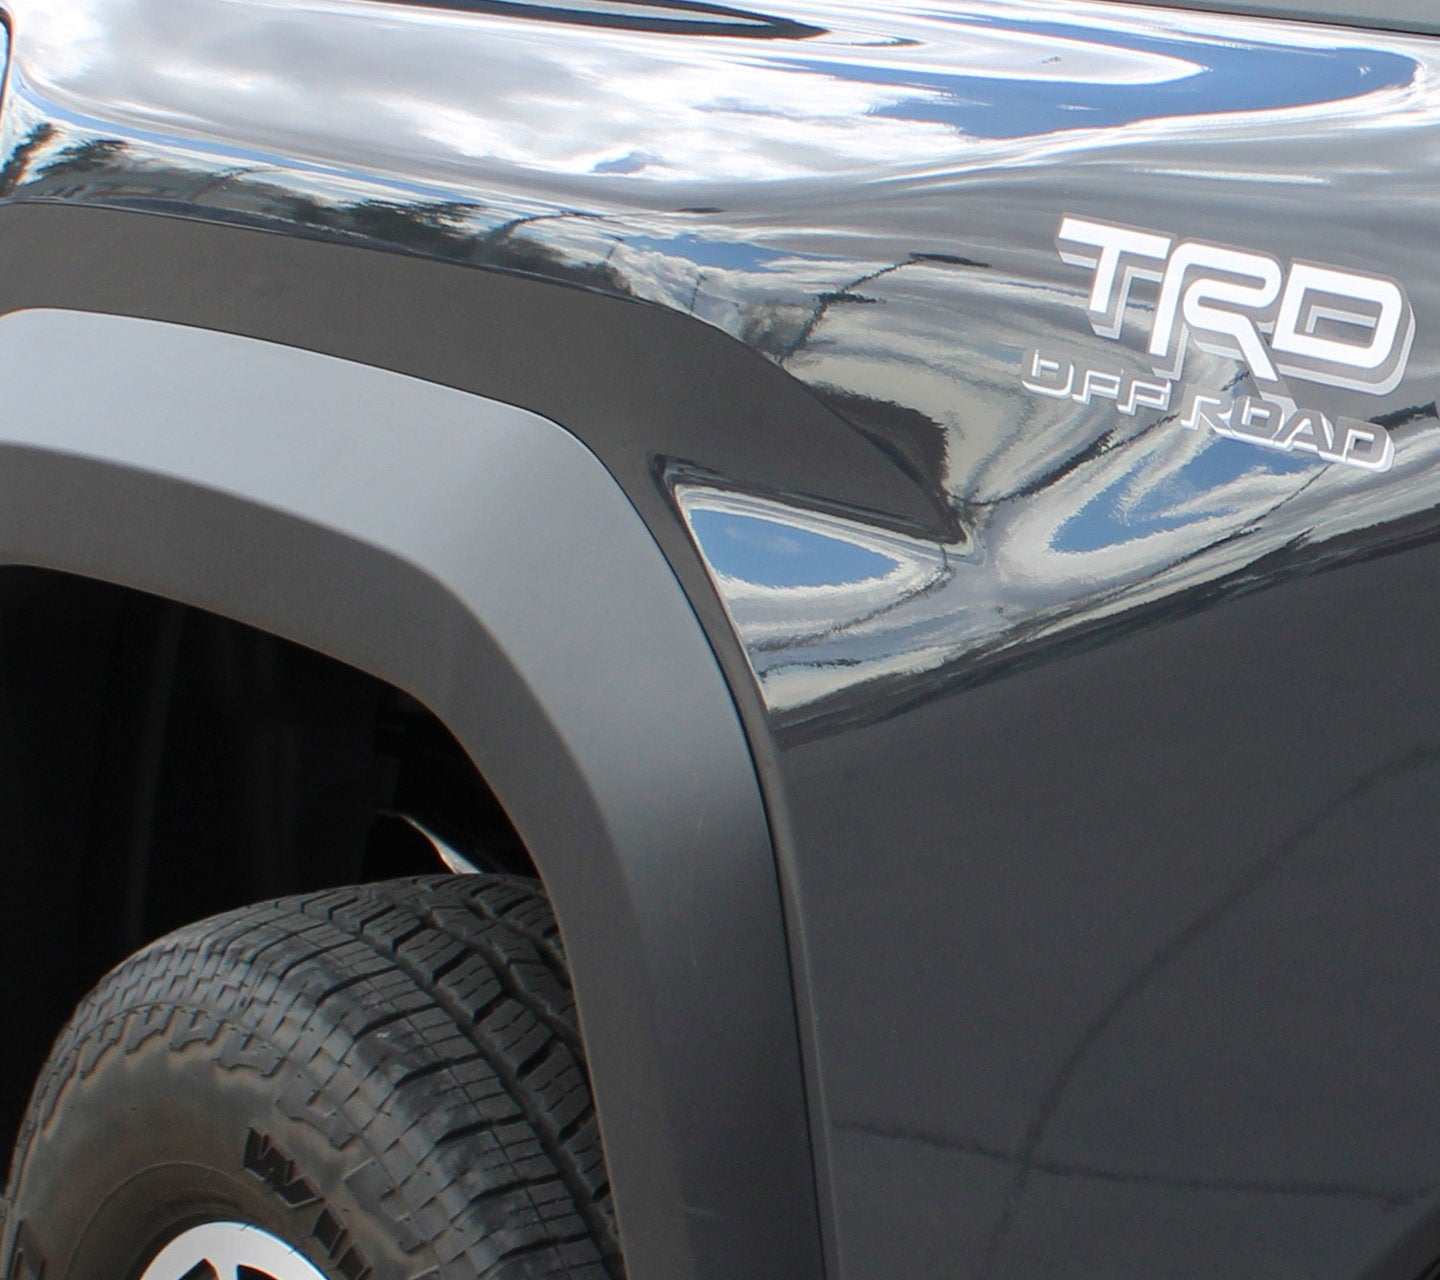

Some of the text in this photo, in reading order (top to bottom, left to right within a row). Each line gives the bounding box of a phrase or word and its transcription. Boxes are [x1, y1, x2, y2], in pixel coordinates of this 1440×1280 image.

[1056, 215, 1415, 396] TRD
[1022, 348, 1394, 473] OFF ROAD
